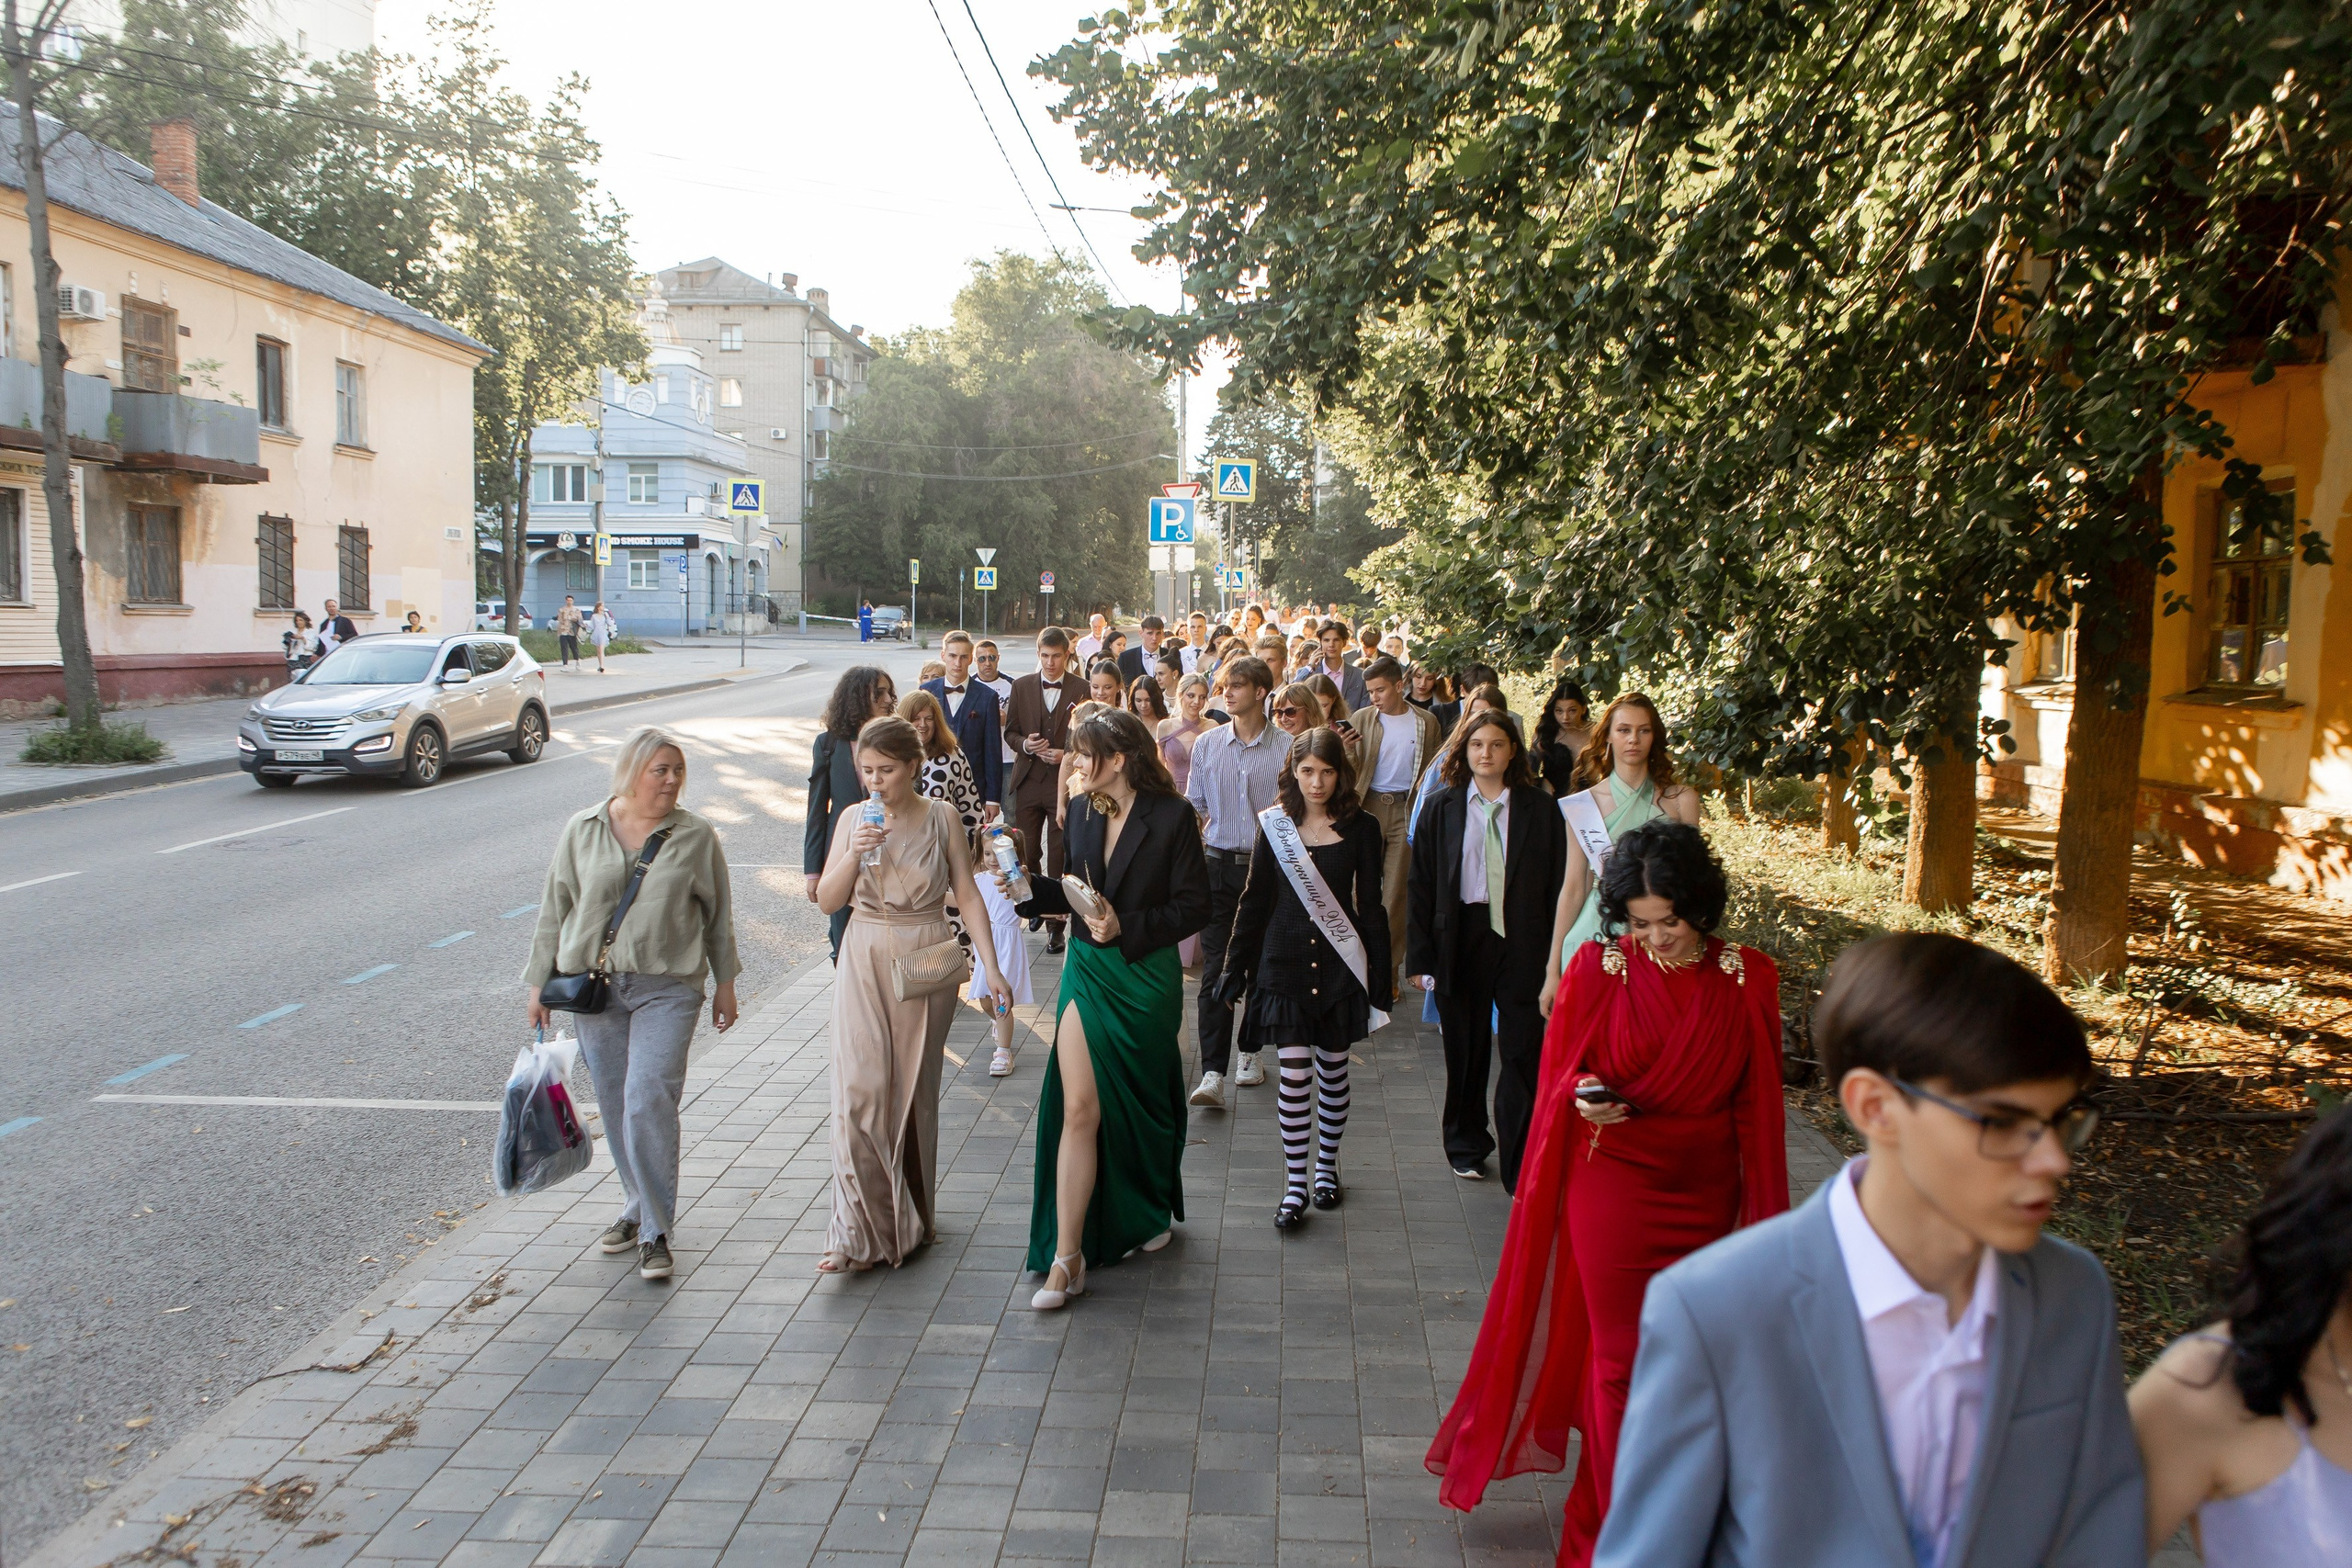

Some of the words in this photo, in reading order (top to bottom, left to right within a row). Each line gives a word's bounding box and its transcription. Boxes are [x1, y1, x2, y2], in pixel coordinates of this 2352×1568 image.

[1160, 502, 1185, 538] P
[620, 536, 653, 546] SMOKE
[653, 536, 684, 546] HOUSE
[1589, 829, 1605, 843] 11
[1272, 817, 1327, 909] Выпускница
[1319, 910, 1357, 943] 2024
